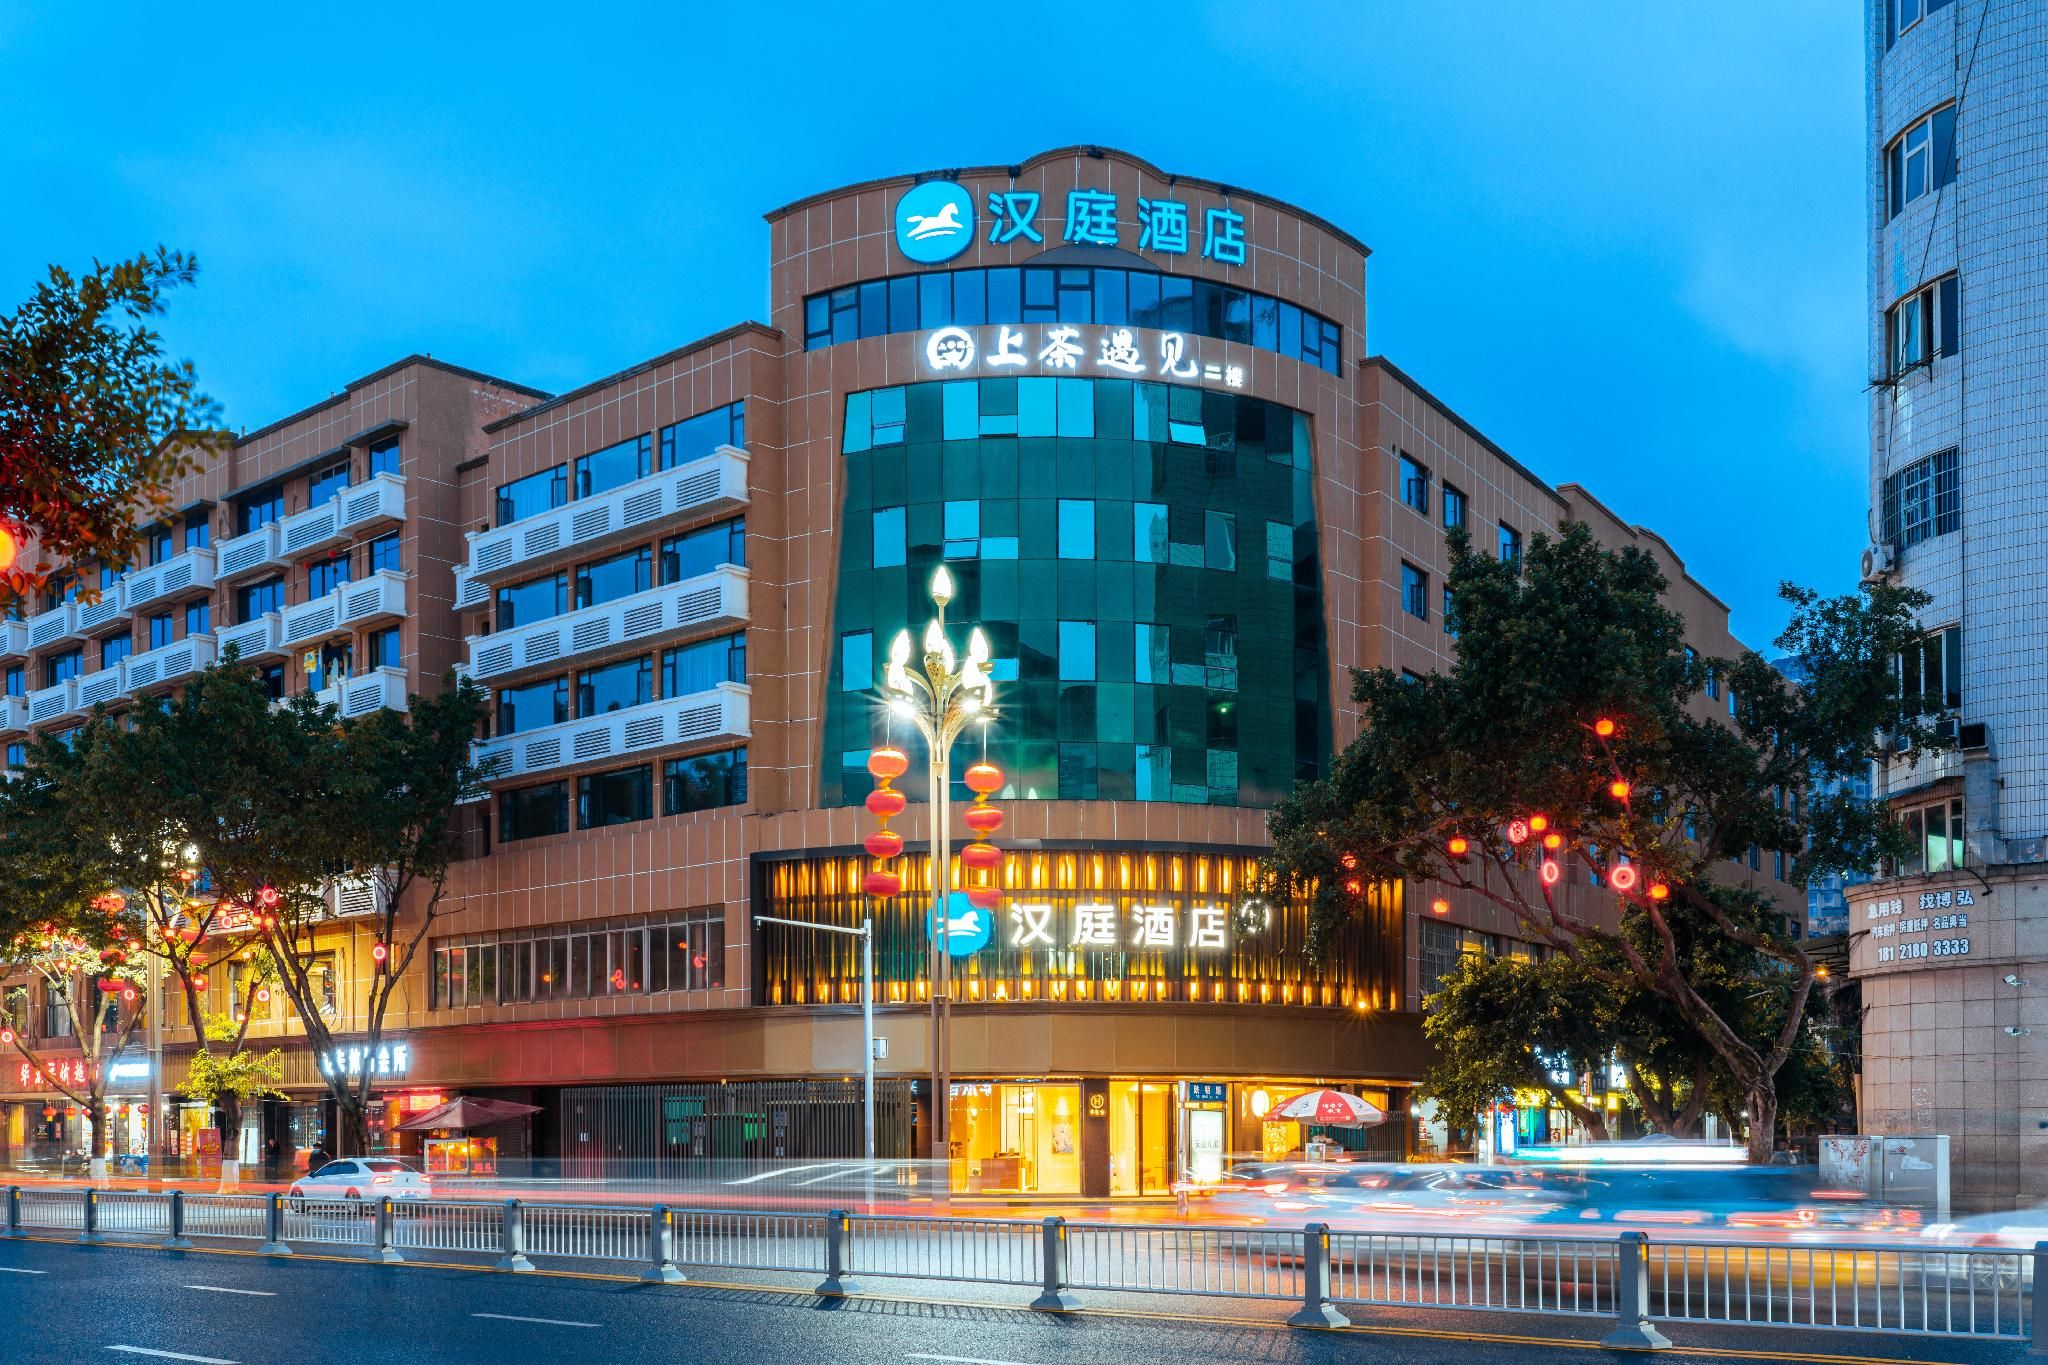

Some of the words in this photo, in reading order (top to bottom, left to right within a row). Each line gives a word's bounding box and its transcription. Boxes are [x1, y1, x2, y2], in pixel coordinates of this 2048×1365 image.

[988, 188, 1247, 265] 汉庭酒店
[986, 326, 1198, 378] 上茶遇见
[1204, 364, 1243, 388] 二楼
[1010, 902, 1226, 948] 汉庭酒店
[1867, 898, 1903, 920] 急用钱
[1933, 914, 1967, 930] 名品典当
[1877, 946, 1894, 962] 181
[1899, 942, 1928, 960] 2180
[1933, 938, 1969, 956] 3333
